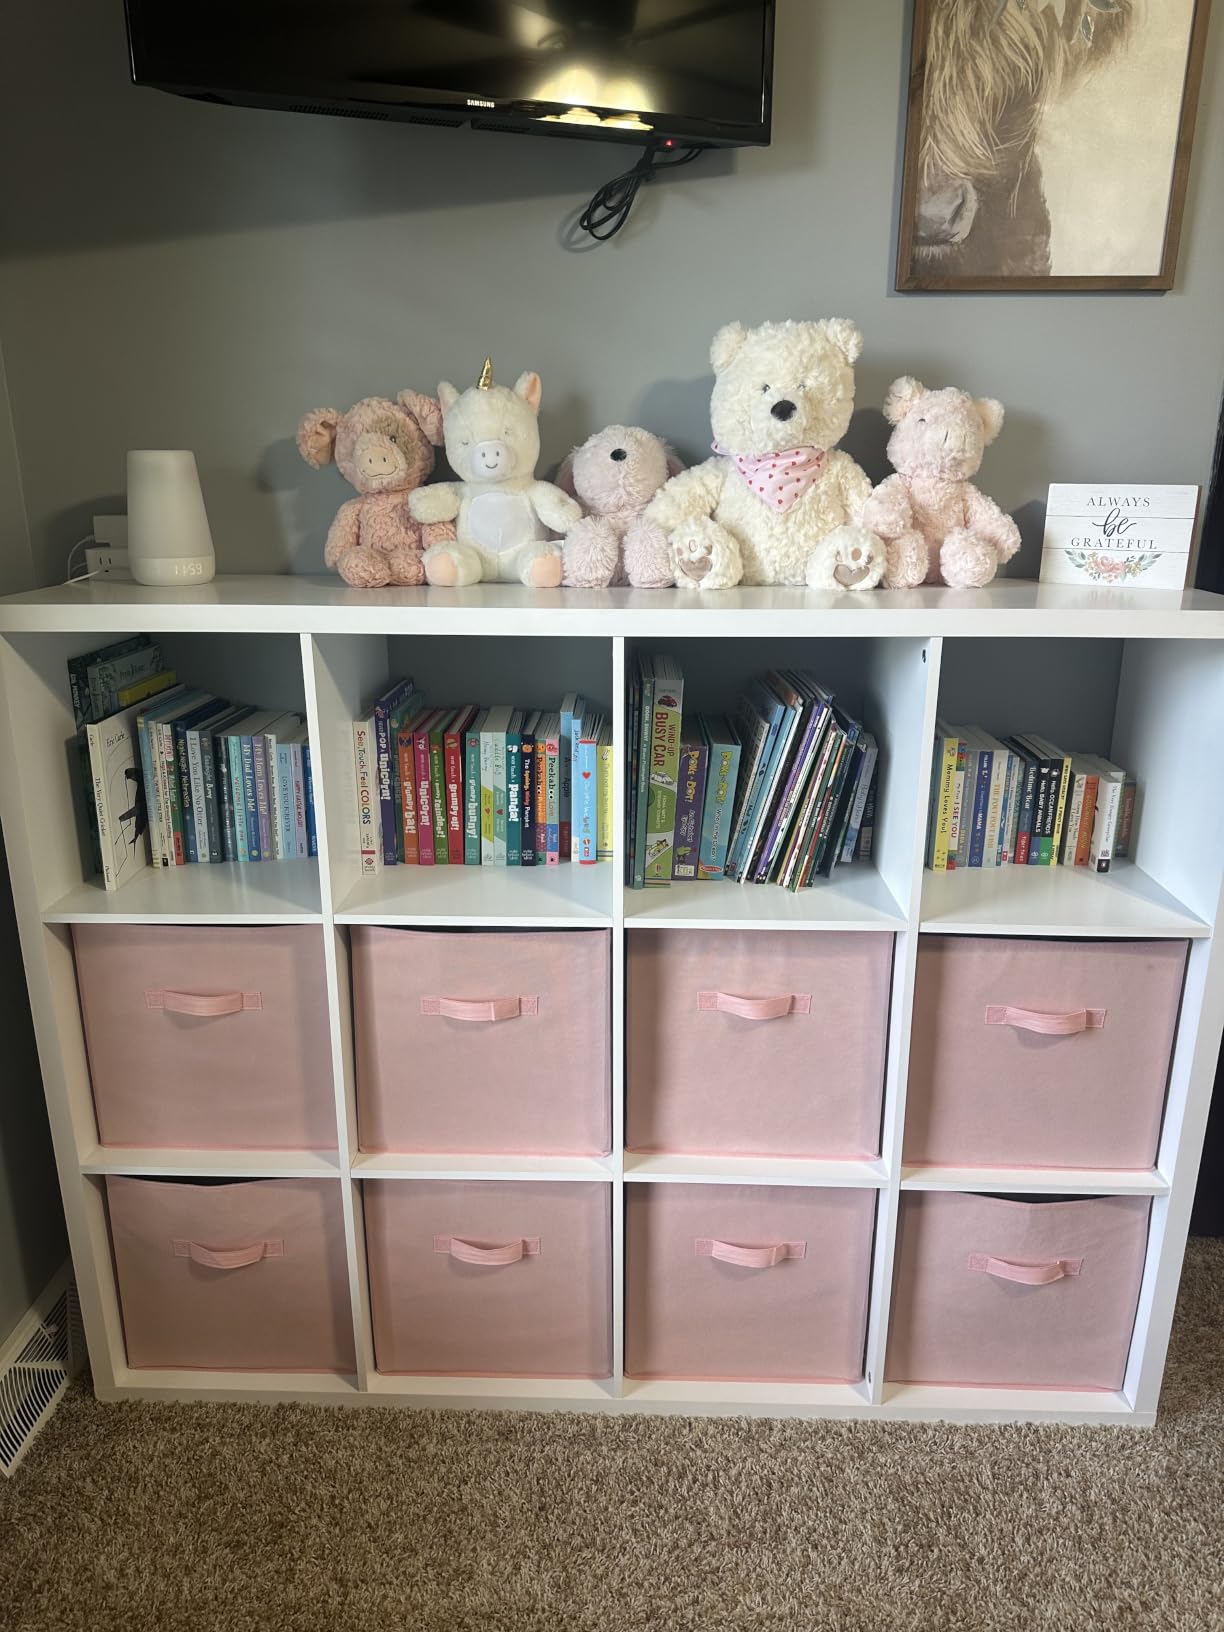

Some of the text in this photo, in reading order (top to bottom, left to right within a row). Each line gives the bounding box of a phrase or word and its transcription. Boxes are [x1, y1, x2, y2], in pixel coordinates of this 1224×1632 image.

[466, 99, 494, 108] SAMSUNG
[1086, 496, 1150, 507] ALWAYS
[1092, 508, 1136, 537] be
[1071, 538, 1158, 550] GRATEFUL
[243, 744, 250, 756] My
[254, 744, 262, 755] My
[654, 712, 668, 766] BUSY CAR
[667, 724, 676, 757] WIND-UP
[360, 771, 368, 788] Feel
[944, 764, 953, 793] Mommy
[1024, 767, 1036, 809] Bedtime Bear
[196, 794, 202, 805] No
[403, 781, 413, 810] grumpy
[448, 784, 458, 816] grumpy
[509, 784, 519, 822] panda!
[684, 781, 697, 803] DOT!
[361, 790, 371, 825] COLORS
[942, 796, 950, 814] Loves
[405, 811, 416, 834] bat!
[450, 816, 459, 830] elf!
[466, 802, 478, 838] bunny!
[1045, 812, 1053, 834] FRIENDS
